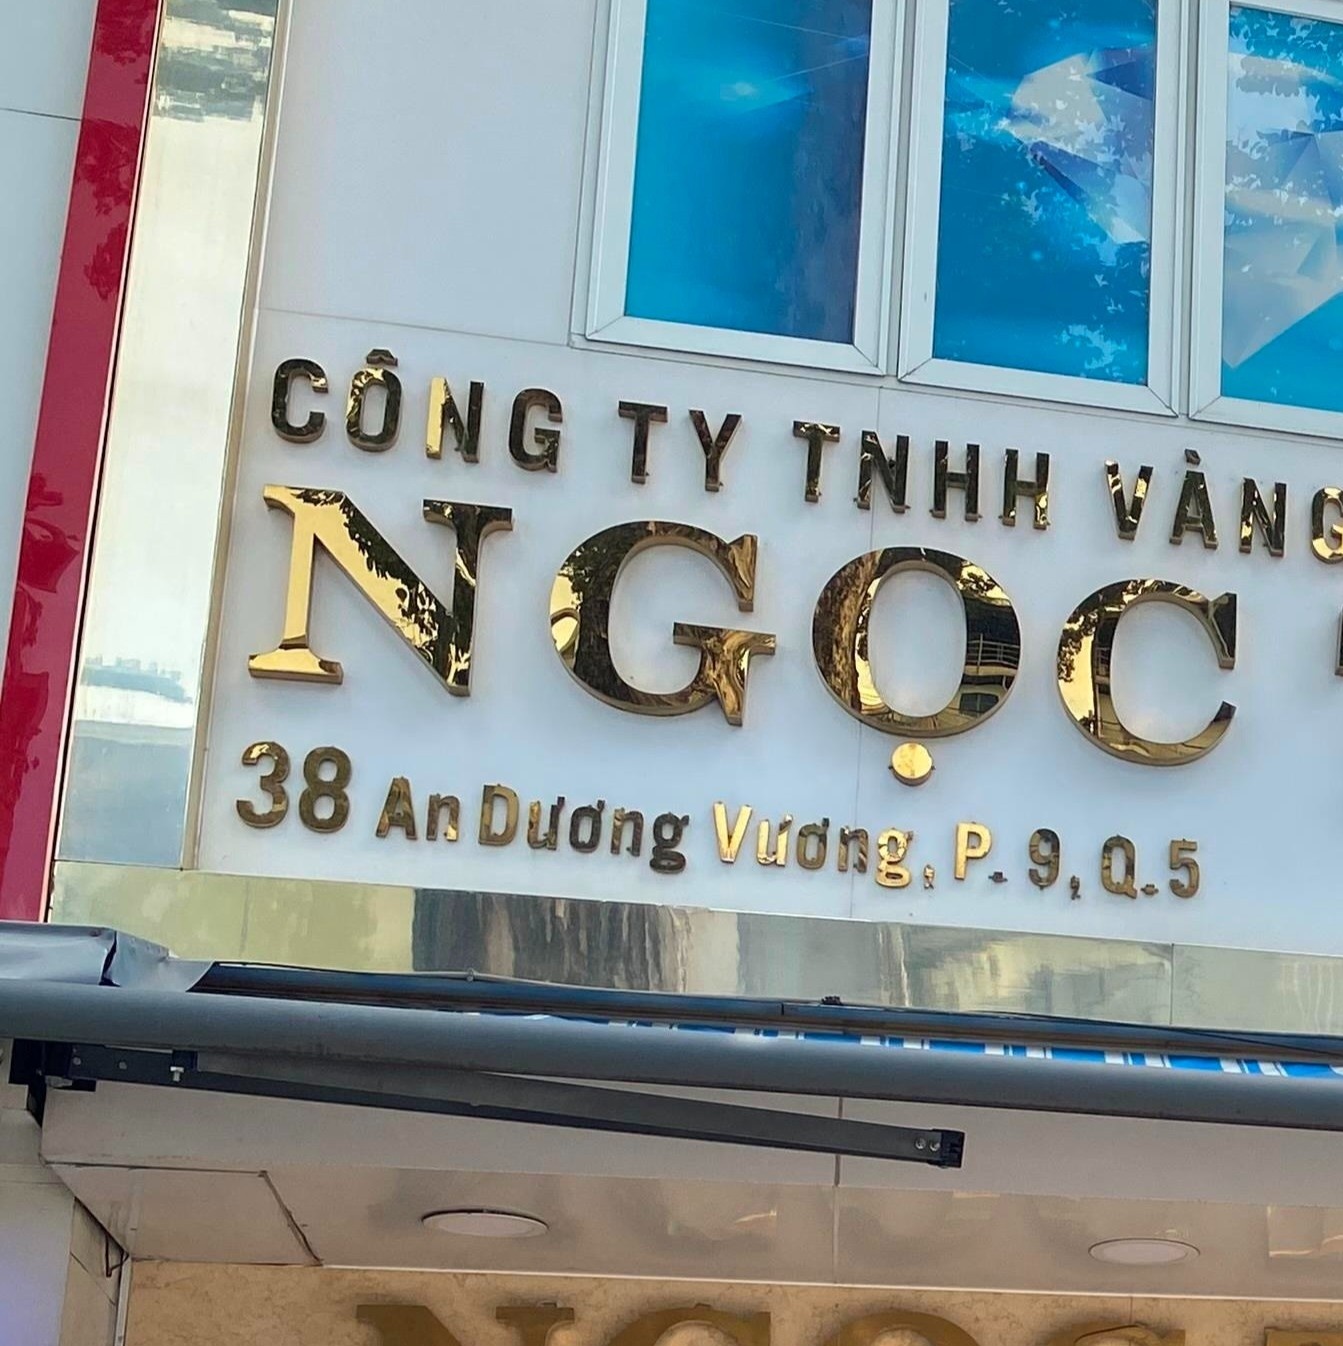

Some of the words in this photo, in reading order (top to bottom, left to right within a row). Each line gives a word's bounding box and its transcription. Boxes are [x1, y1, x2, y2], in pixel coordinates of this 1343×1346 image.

[270, 348, 563, 473] CÔNG
[618, 400, 742, 492] TY
[792, 420, 1050, 530] TNHH
[248, 484, 1237, 787] NGỌC
[235, 740, 352, 833] 38
